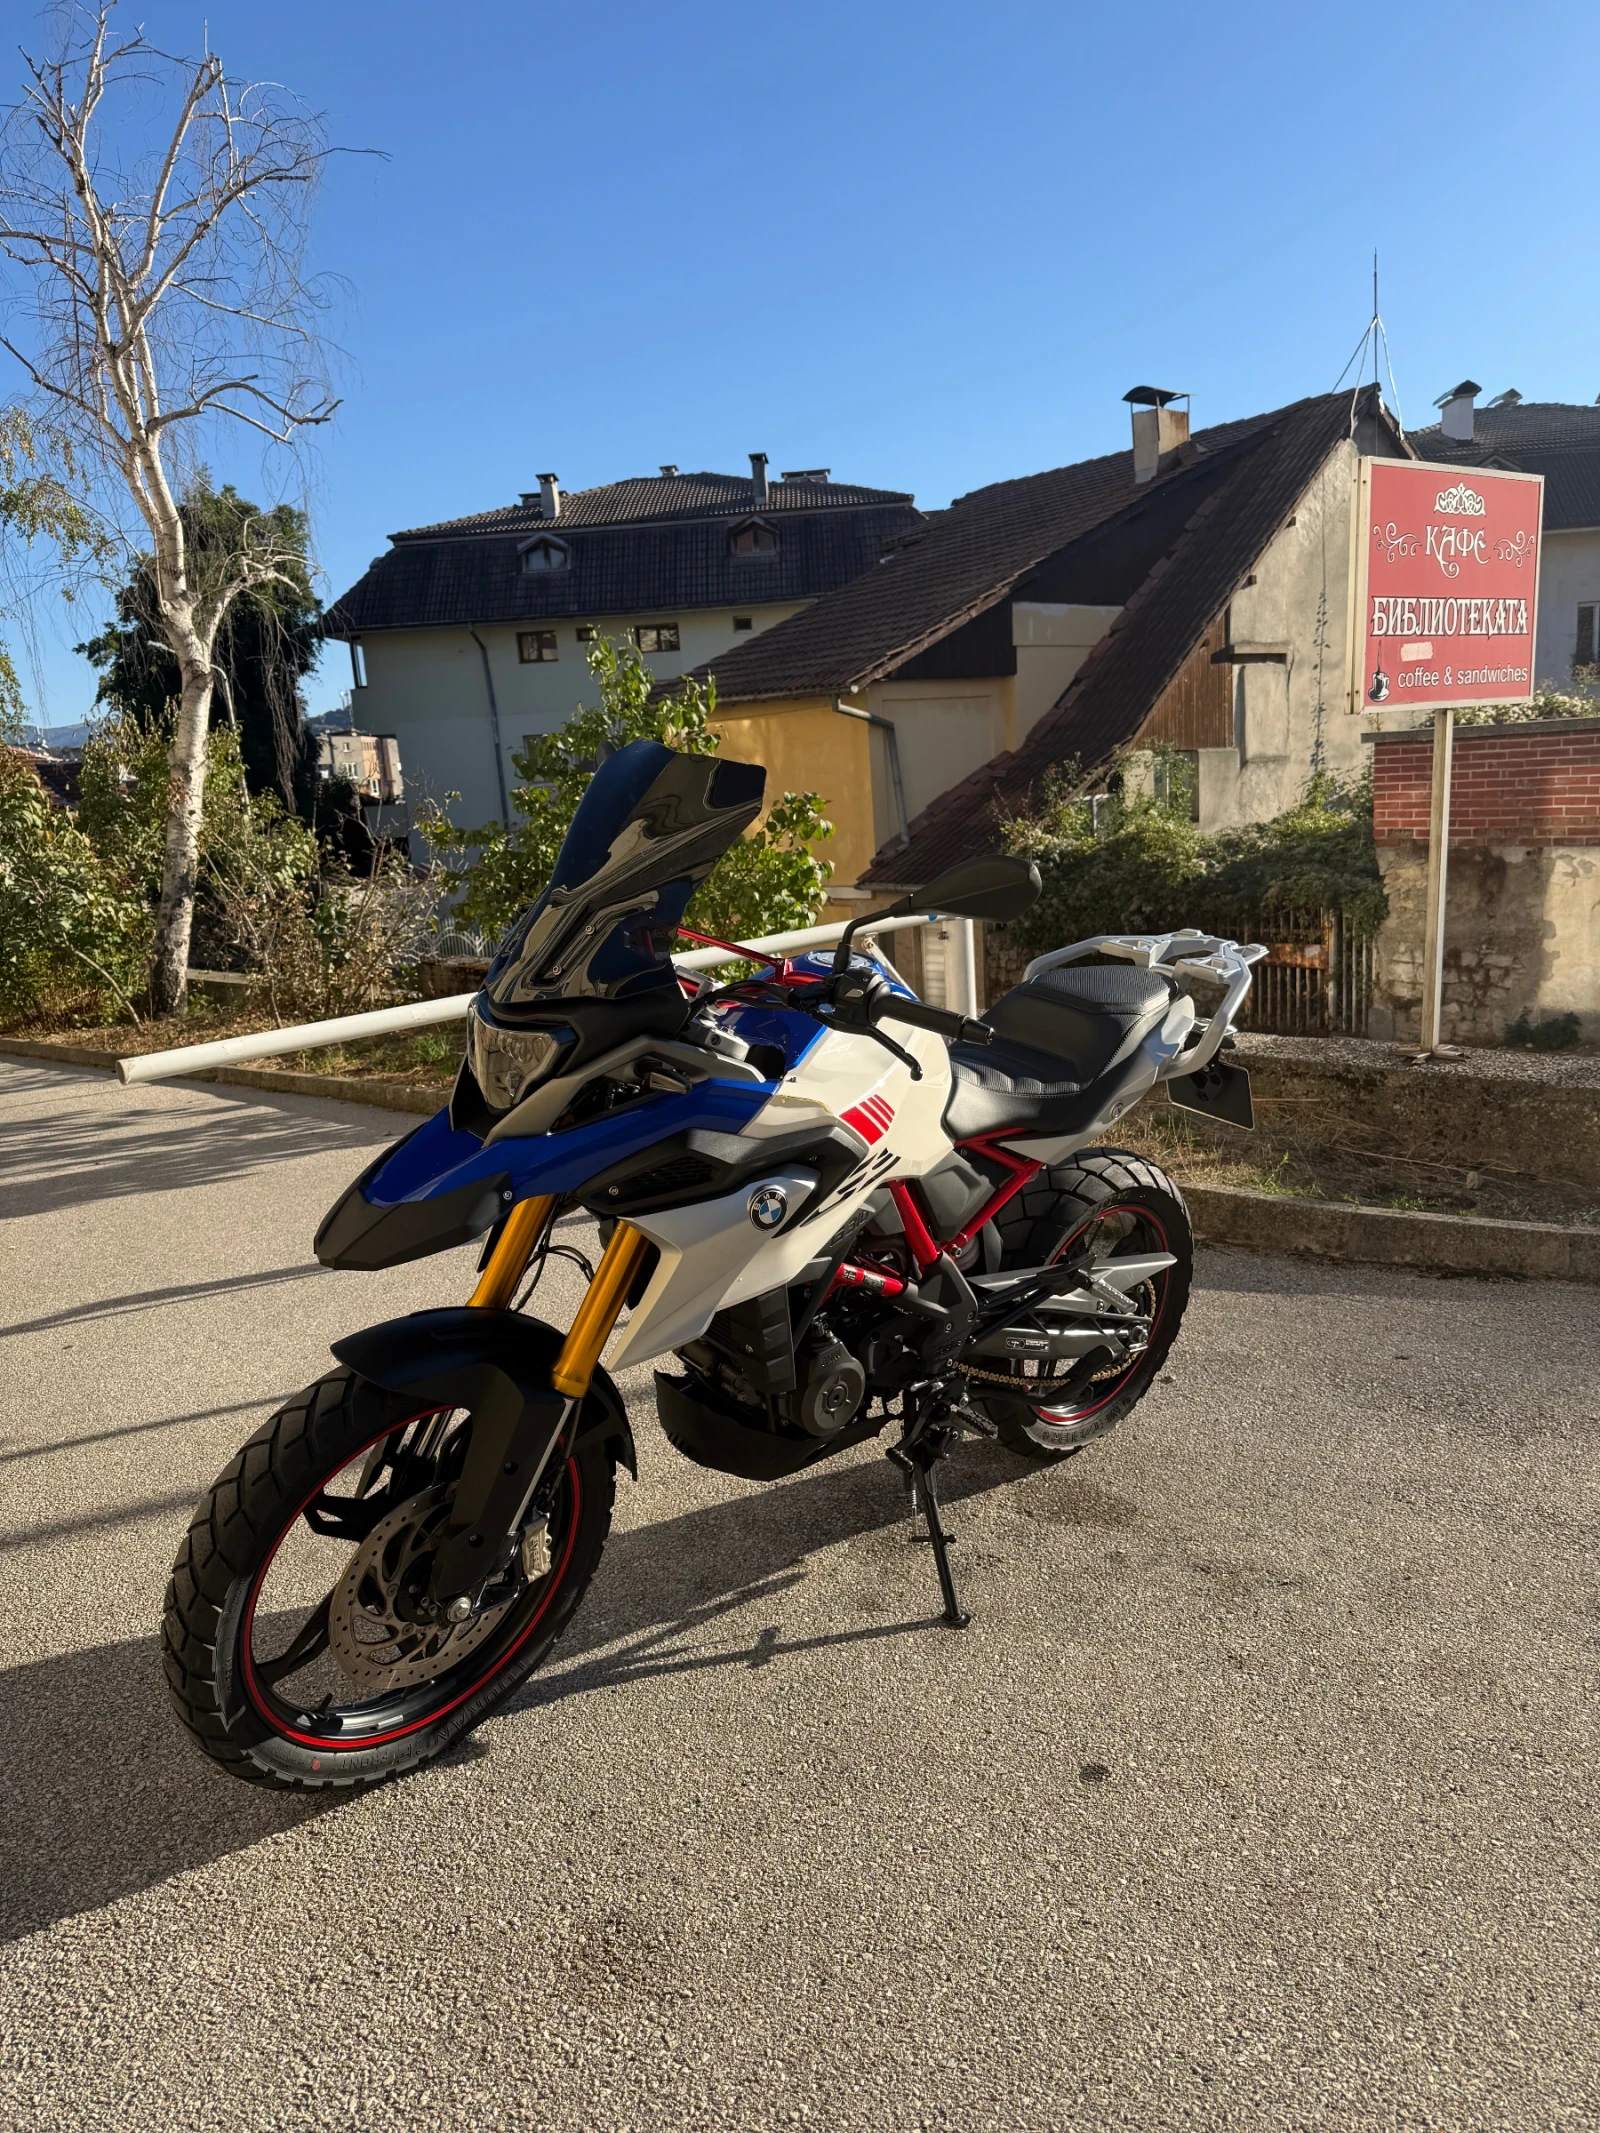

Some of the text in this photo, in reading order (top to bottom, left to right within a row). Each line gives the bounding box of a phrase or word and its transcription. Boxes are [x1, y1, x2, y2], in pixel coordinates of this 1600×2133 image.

[1425, 524, 1490, 578] КАФЕ
[1371, 596, 1529, 638] БИБЛИОТЕКАТА
[1398, 664, 1528, 688] coffee & sandwiches
